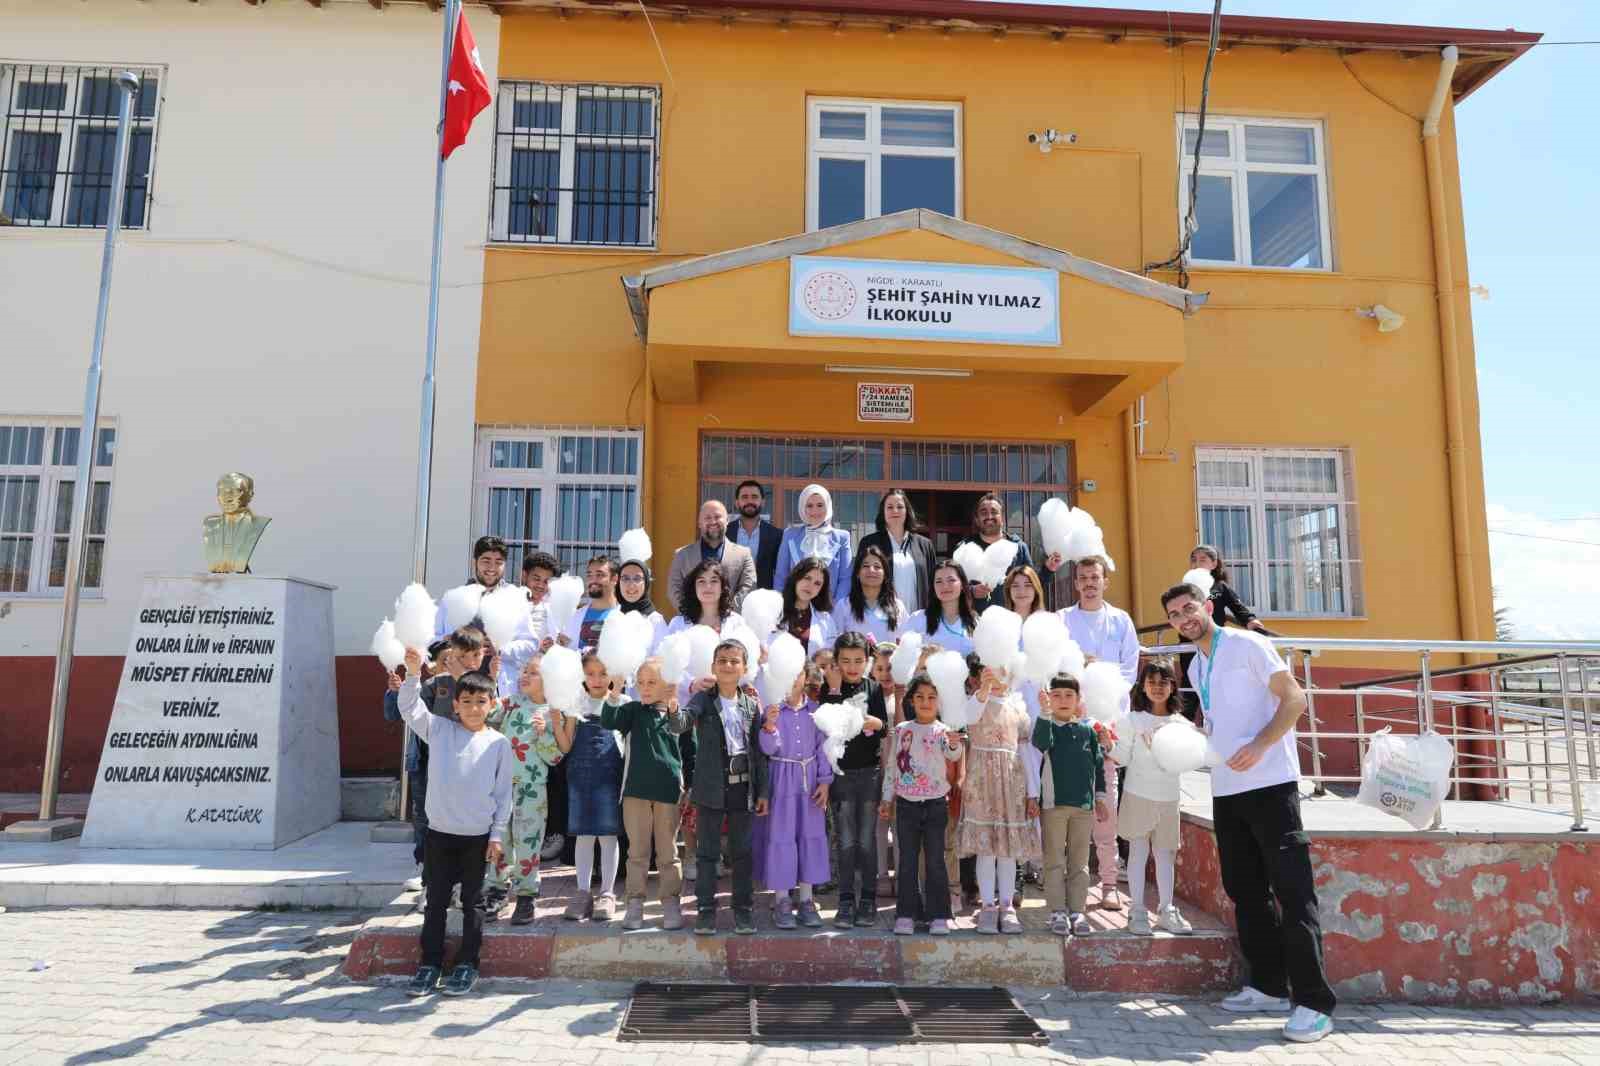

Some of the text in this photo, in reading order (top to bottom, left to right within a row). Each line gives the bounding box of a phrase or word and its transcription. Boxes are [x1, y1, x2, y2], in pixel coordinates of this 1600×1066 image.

[902, 277, 943, 288] KARAATLI
[867, 287, 1041, 308] ŞEHİT ŞAHİN YILMAZ
[867, 305, 952, 323] İLKOKULU
[140, 605, 275, 628] GENÇLİĞİ YETİŞTİRİNİZ.
[135, 634, 275, 655] ONLARA İLİM ve İRFANIN
[130, 662, 275, 684] MÜSPET FİKİRLERİNİ
[162, 697, 221, 718] VERİNİZ.
[109, 729, 258, 749] GELECEĞİN AYDINLIĞINA
[104, 766, 272, 787] ONLARLA KAVUŞACAKSINIZ.
